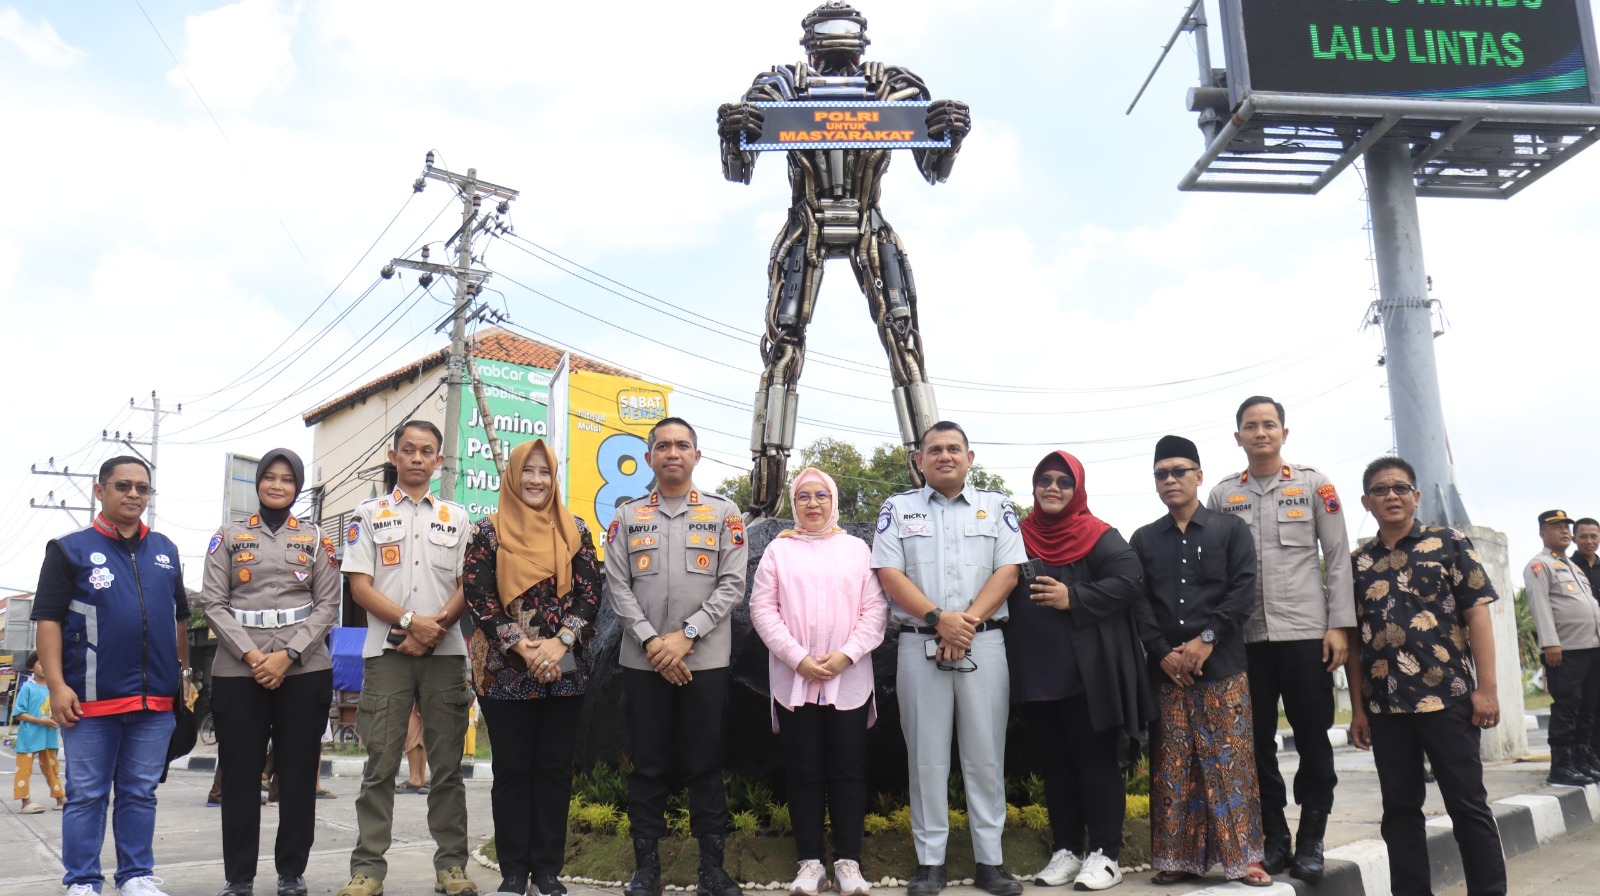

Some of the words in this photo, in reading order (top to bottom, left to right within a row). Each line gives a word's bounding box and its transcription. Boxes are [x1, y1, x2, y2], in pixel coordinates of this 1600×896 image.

[1309, 23, 1396, 63] LALU
[1405, 28, 1525, 68] LINTAS
[814, 111, 879, 122] POLRI
[826, 122, 866, 131] UNTUK
[779, 130, 914, 142] MASYARAKAT
[475, 364, 524, 381] rabCar
[621, 395, 661, 408] SOBAT
[622, 406, 665, 420] HEMAT
[578, 421, 602, 433] Mulai
[1278, 498, 1308, 506] POLRI
[431, 522, 445, 532] POL
[447, 526, 457, 534] PP
[628, 525, 650, 534] BAYU
[688, 523, 717, 531] POLRI
[232, 543, 259, 551] WURI
[286, 543, 314, 556] POLRI
